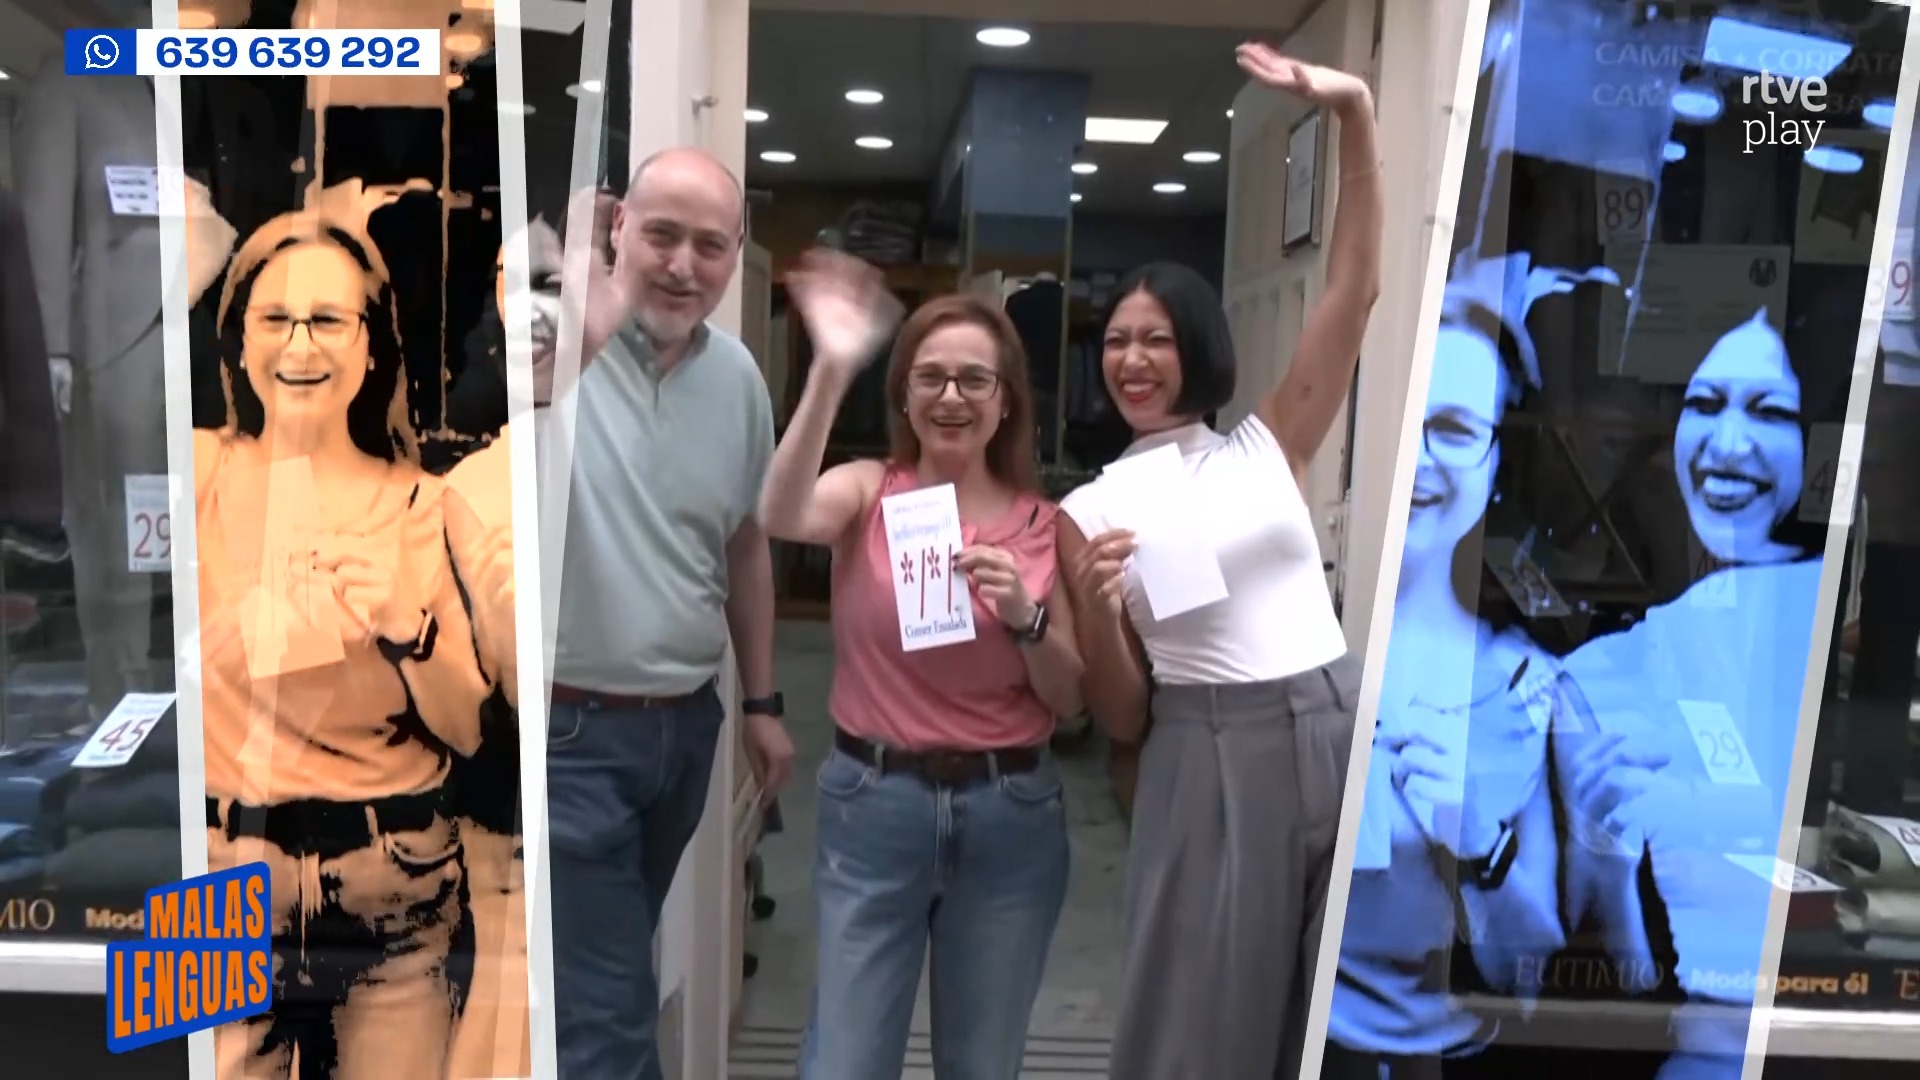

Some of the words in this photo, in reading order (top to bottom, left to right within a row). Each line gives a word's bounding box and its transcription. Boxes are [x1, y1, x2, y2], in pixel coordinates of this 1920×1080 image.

[1603, 187, 1644, 231] 89
[133, 513, 172, 559] 29
[100, 719, 154, 754] 45
[1699, 729, 1744, 769] 29
[1690, 967, 1768, 991] Moda
[1774, 976, 1839, 994] para
[1844, 971, 1869, 995] él
